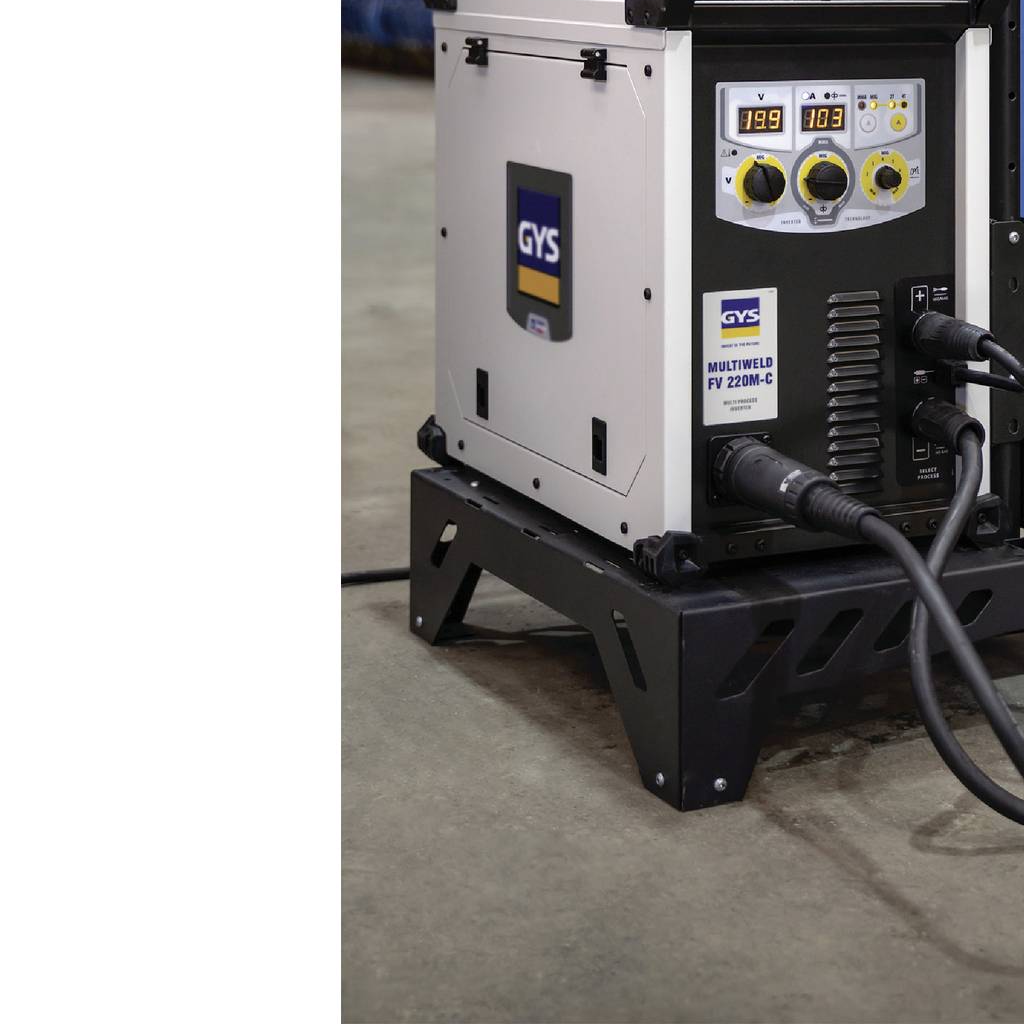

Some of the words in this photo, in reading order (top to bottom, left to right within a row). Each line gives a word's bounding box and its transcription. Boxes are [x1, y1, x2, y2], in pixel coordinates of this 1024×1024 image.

[757, 93, 765, 101] V
[809, 108, 843, 129] 103
[725, 176, 732, 185] V
[518, 220, 561, 263] GYS
[720, 308, 761, 325] GYS
[708, 356, 773, 373] MULTIWELD
[707, 376, 723, 390] FV
[727, 372, 773, 388] 220M-C
